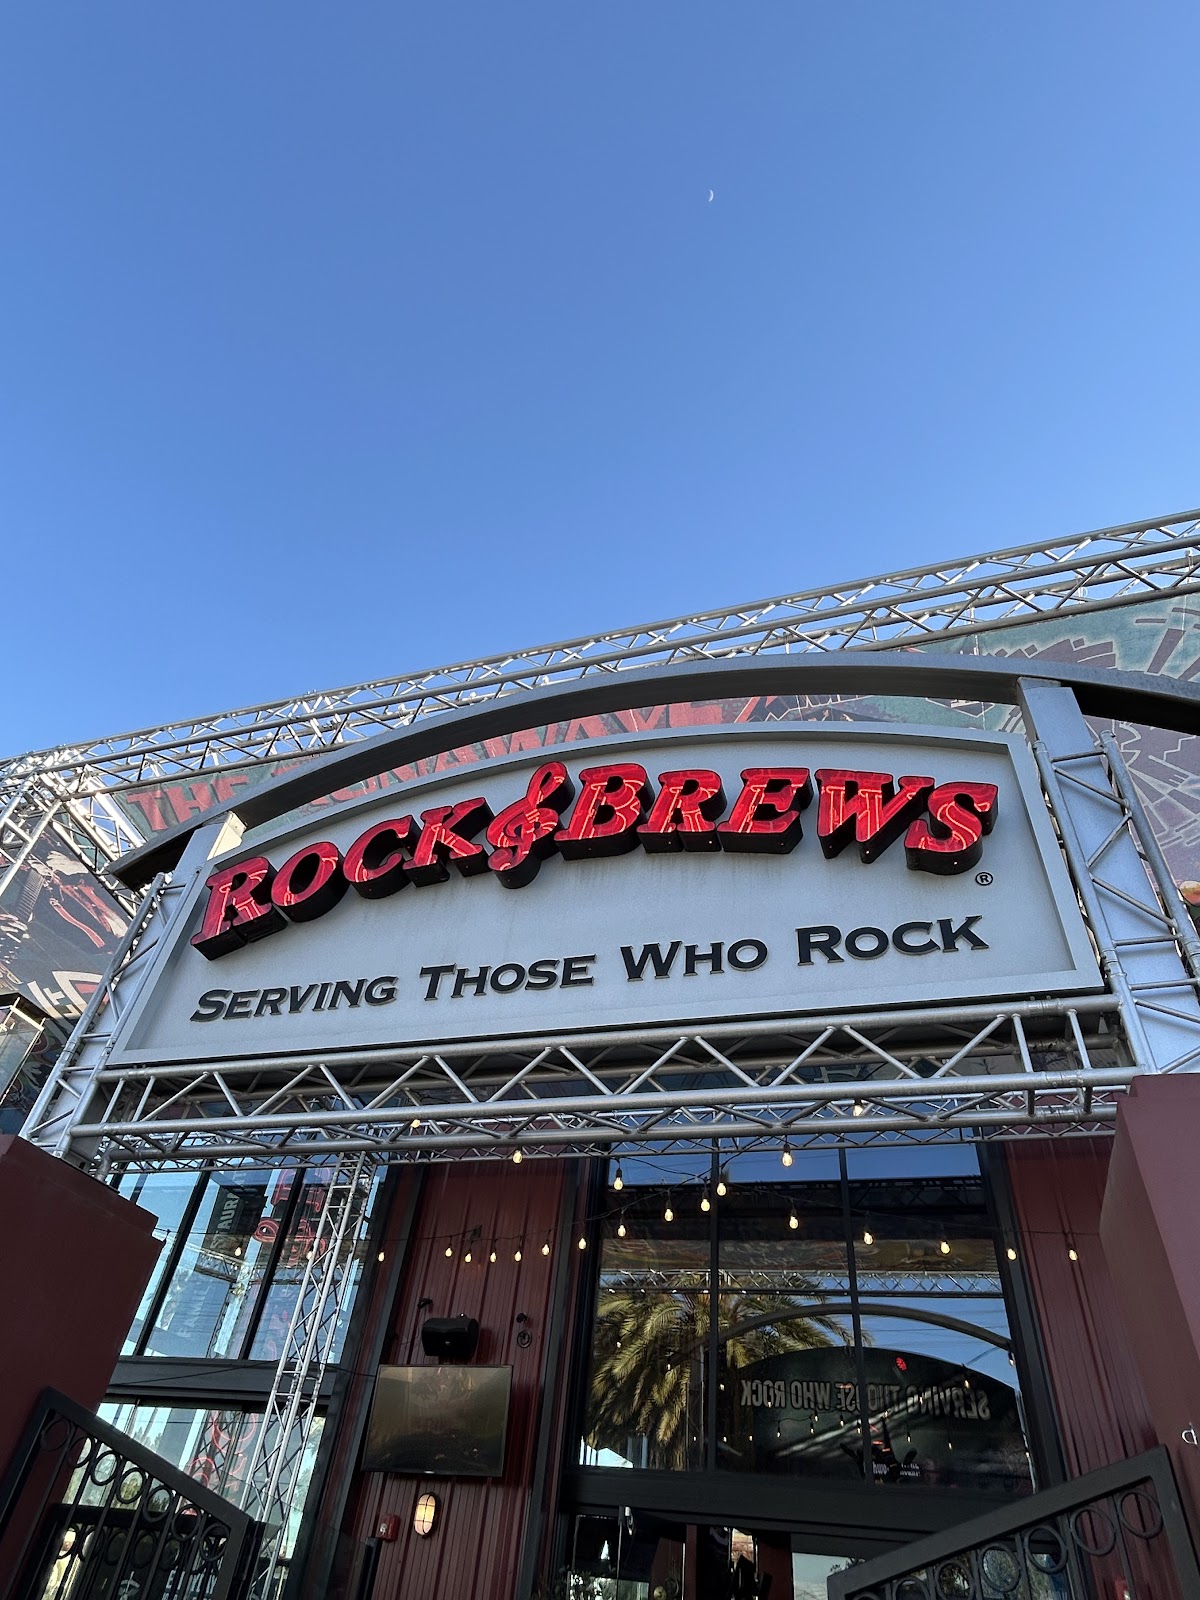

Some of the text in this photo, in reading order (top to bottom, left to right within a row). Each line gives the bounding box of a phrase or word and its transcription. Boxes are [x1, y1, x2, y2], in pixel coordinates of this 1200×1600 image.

[554, 763, 998, 875] BREWS
[190, 914, 989, 1022] SERVING THOSE WHO ROCK
